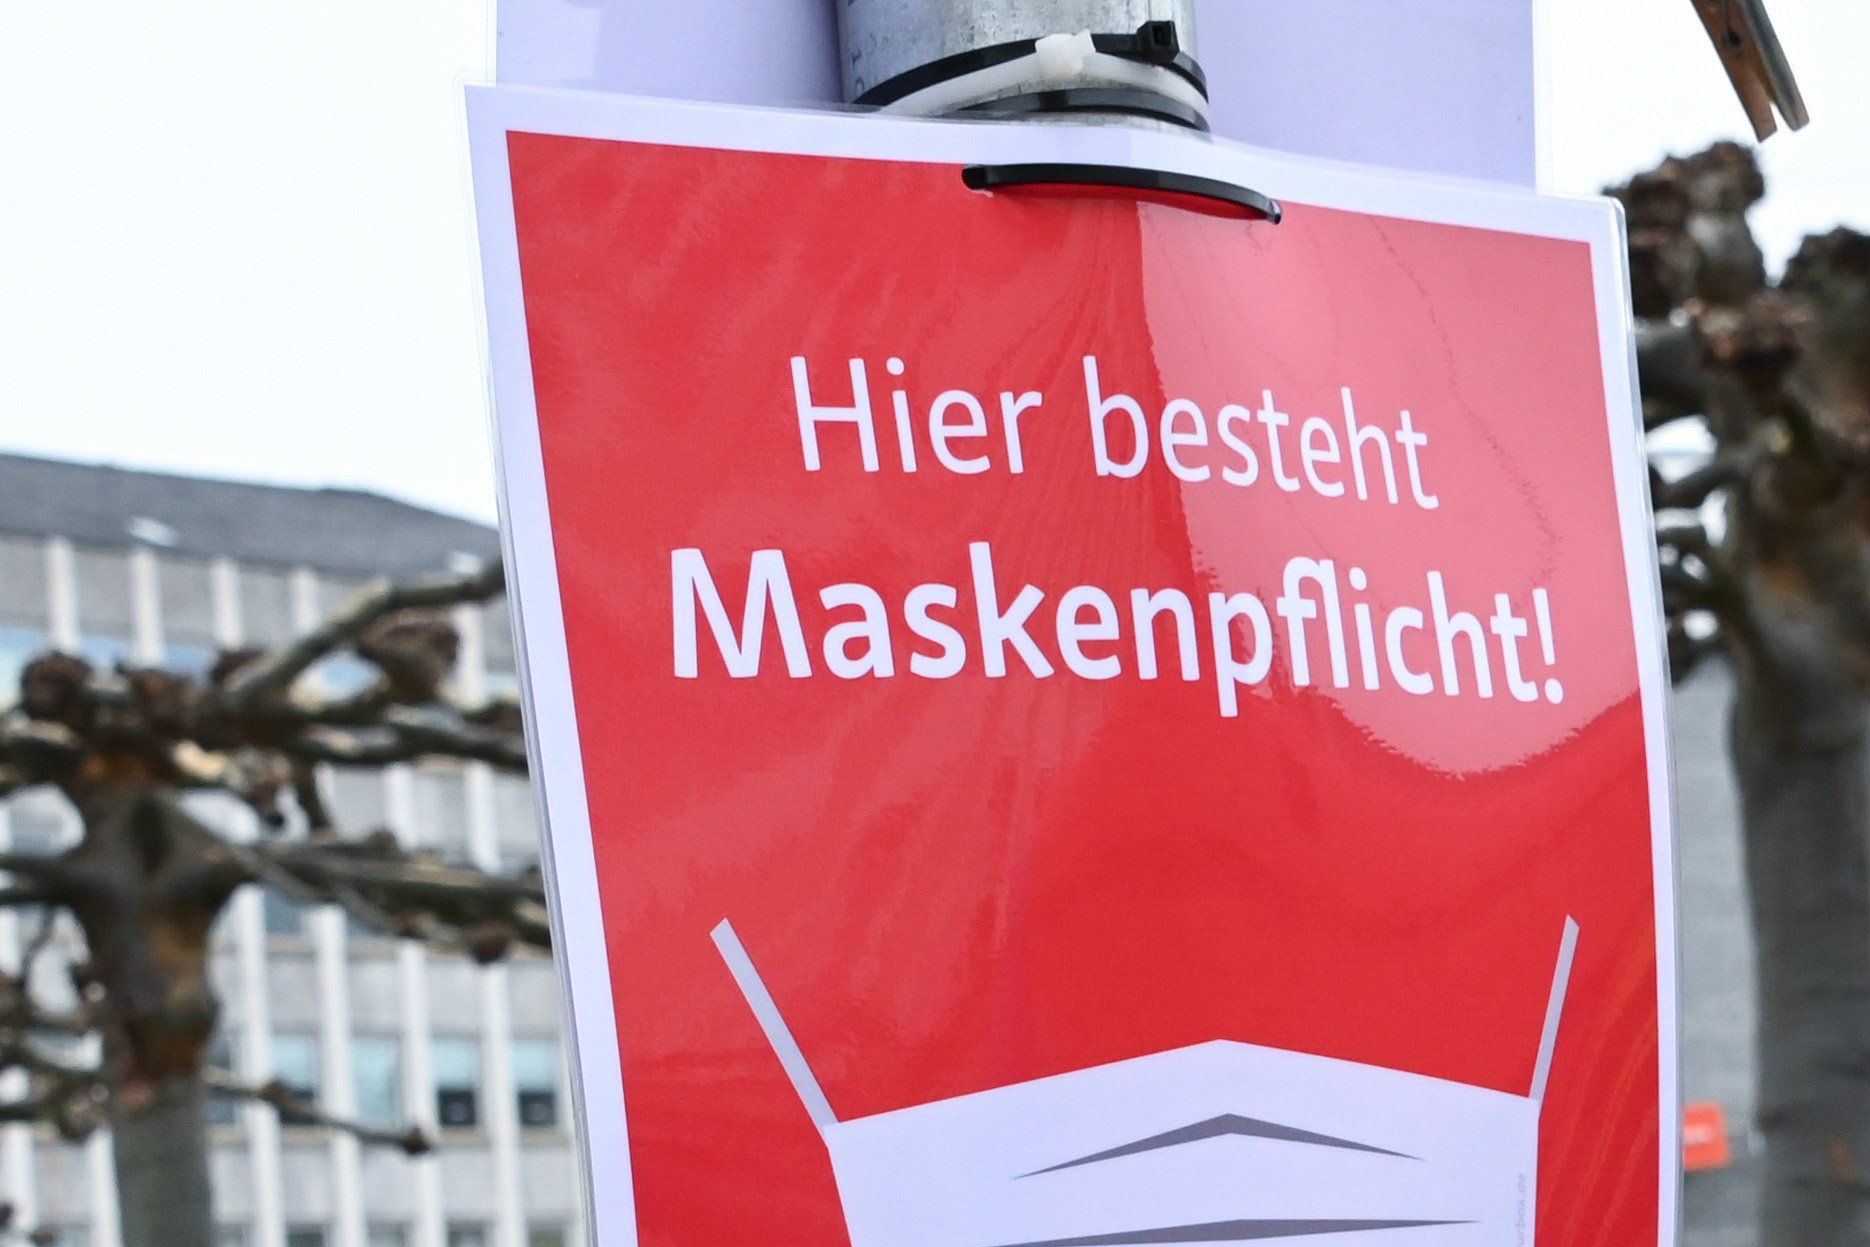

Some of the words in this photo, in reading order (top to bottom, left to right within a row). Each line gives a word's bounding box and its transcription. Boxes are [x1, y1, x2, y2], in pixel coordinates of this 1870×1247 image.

[791, 356, 1042, 473] Hier
[1083, 356, 1440, 510] besteht
[671, 542, 1565, 717] Maskenpflicht!
